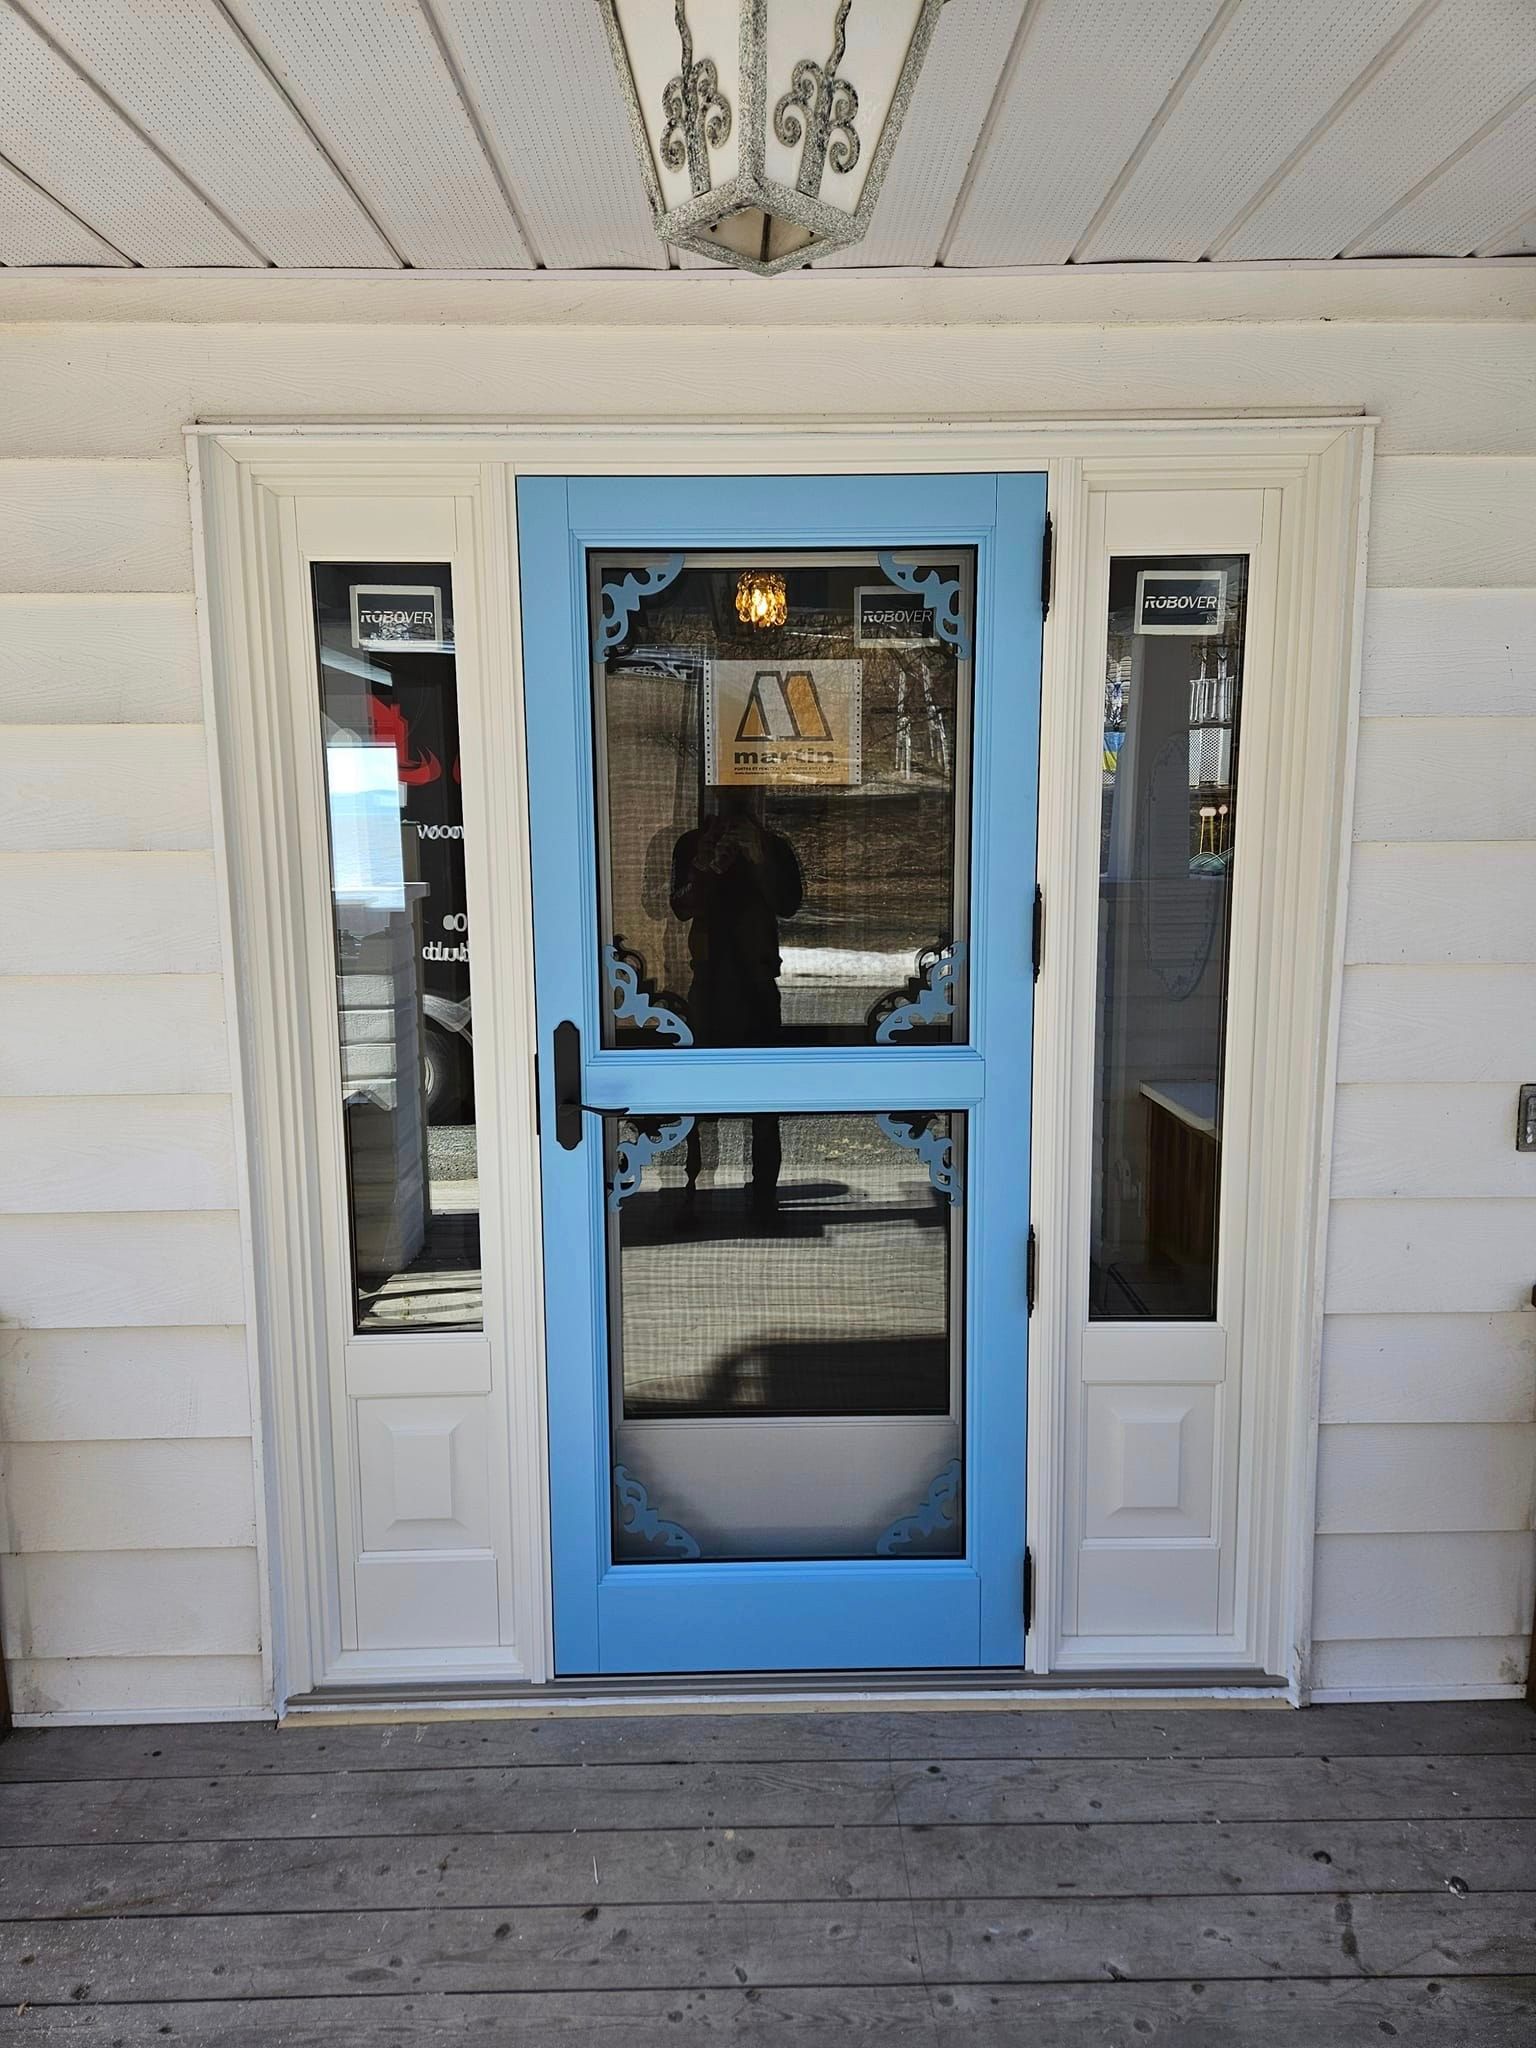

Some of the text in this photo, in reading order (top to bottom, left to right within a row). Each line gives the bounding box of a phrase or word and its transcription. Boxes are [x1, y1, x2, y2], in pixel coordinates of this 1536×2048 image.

[1144, 595, 1217, 609] ROBOVER
[360, 610, 433, 624] ROBOVER
[863, 610, 933, 623] ROBOVER
[734, 748, 834, 764] martin
